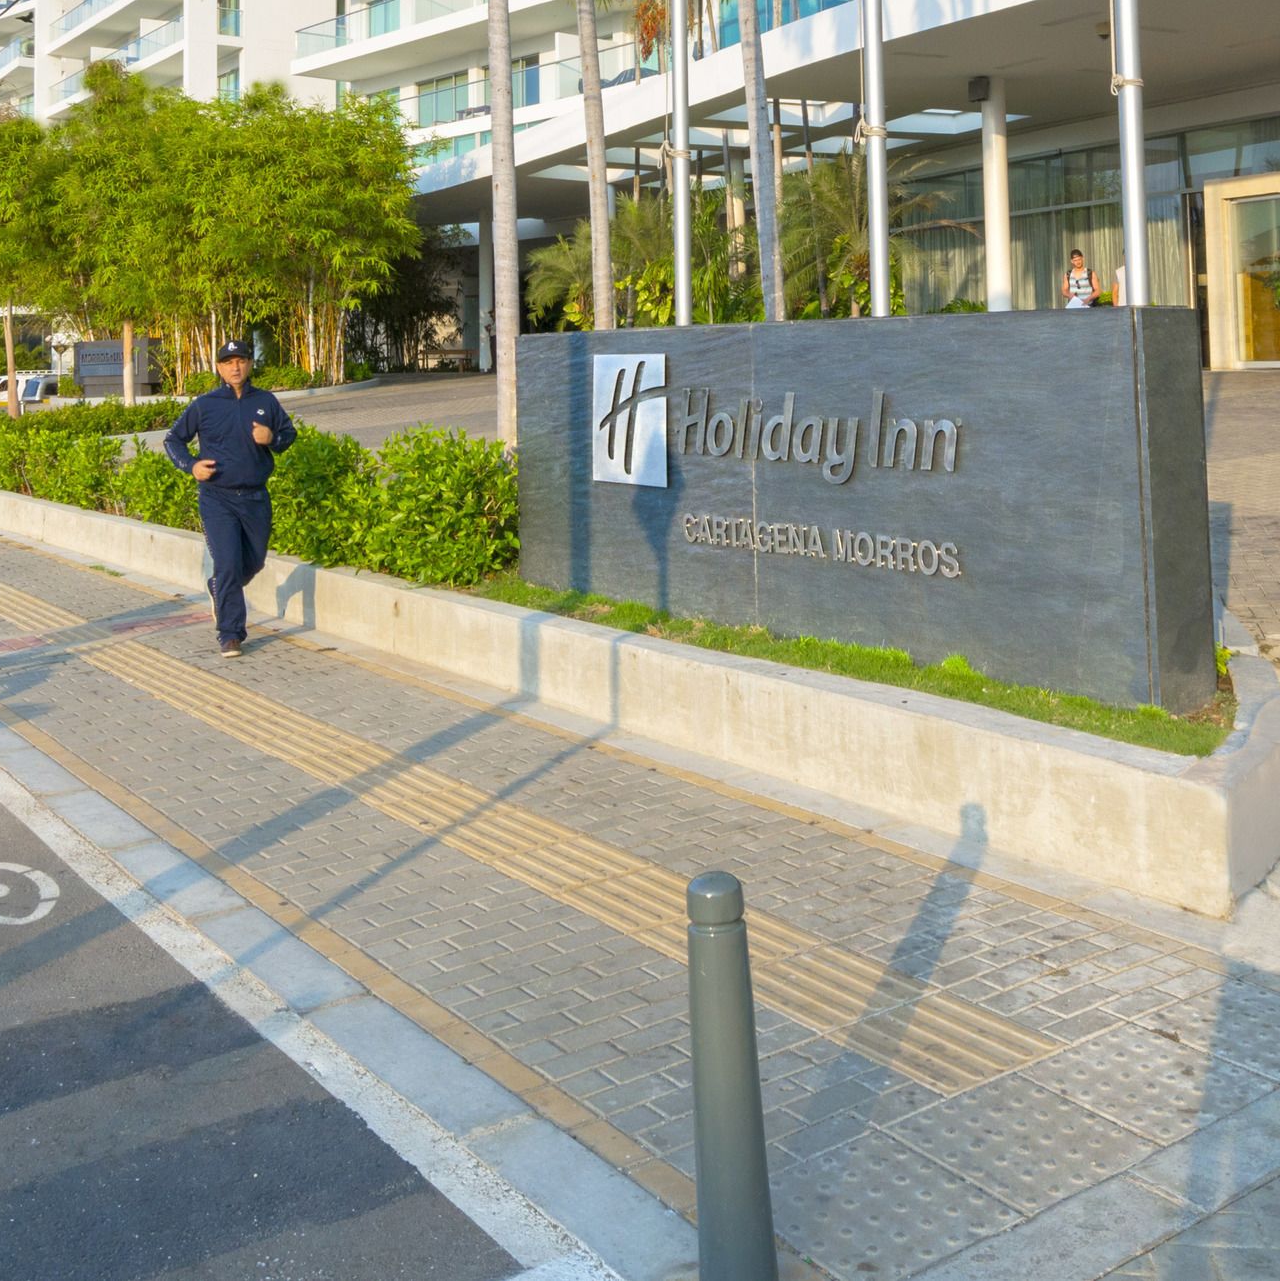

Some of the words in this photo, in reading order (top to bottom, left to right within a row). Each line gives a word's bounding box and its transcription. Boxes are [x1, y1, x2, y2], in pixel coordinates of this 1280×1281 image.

[677, 387, 857, 485] Holiday
[868, 390, 958, 473] Inn
[682, 513, 826, 559] CARTAGENA
[833, 528, 962, 579] MORROS
